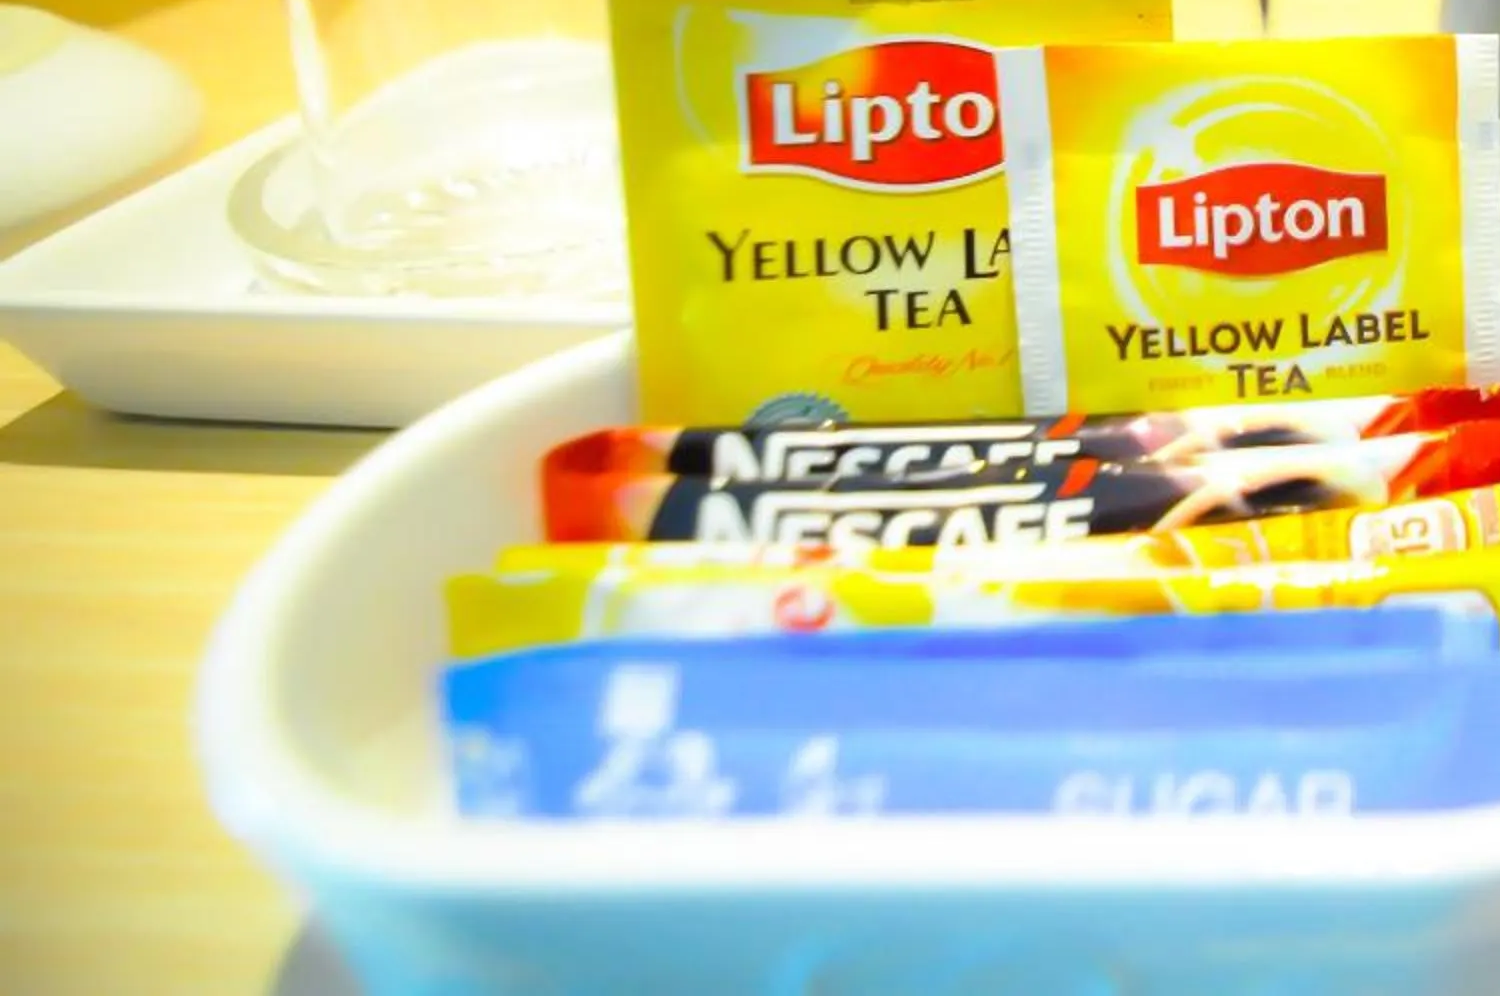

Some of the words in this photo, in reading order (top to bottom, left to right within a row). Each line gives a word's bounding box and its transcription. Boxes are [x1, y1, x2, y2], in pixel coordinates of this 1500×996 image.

[771, 79, 995, 161] Lipto
[1157, 190, 1365, 259] Lipton
[705, 228, 936, 282] YELLOW
[865, 288, 972, 331] TEA
[1107, 318, 1283, 360] YELLOW
[1300, 309, 1430, 349] LABEL
[1227, 362, 1313, 399] TEA
